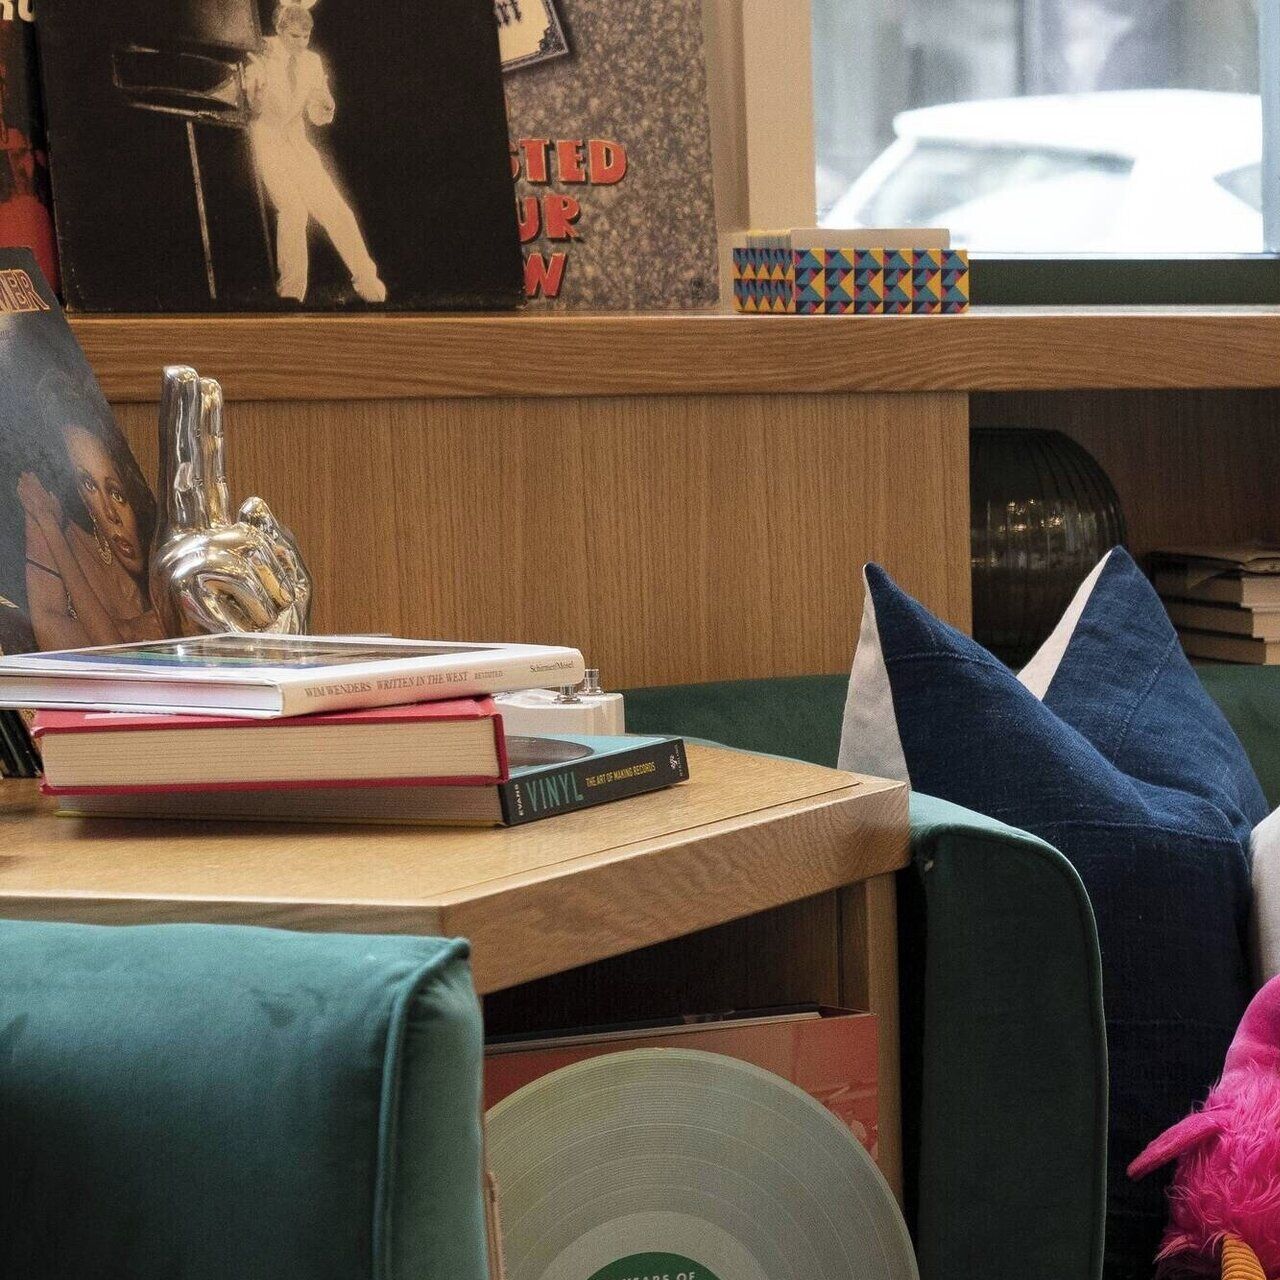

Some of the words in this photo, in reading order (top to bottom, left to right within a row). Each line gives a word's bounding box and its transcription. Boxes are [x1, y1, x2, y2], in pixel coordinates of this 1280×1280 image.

[304, 686, 325, 697] WIM
[325, 681, 372, 696] WENDERS
[377, 676, 415, 690] WRITTEN
[416, 676, 425, 687] IN
[426, 674, 443, 685] THE
[445, 671, 468, 683] WEST
[585, 776, 597, 788] THE
[597, 773, 606, 785] ART
[606, 771, 613, 783] OF
[613, 767, 633, 780] MAKING
[633, 761, 656, 776] RECORDS
[526, 771, 584, 812] VINYL
